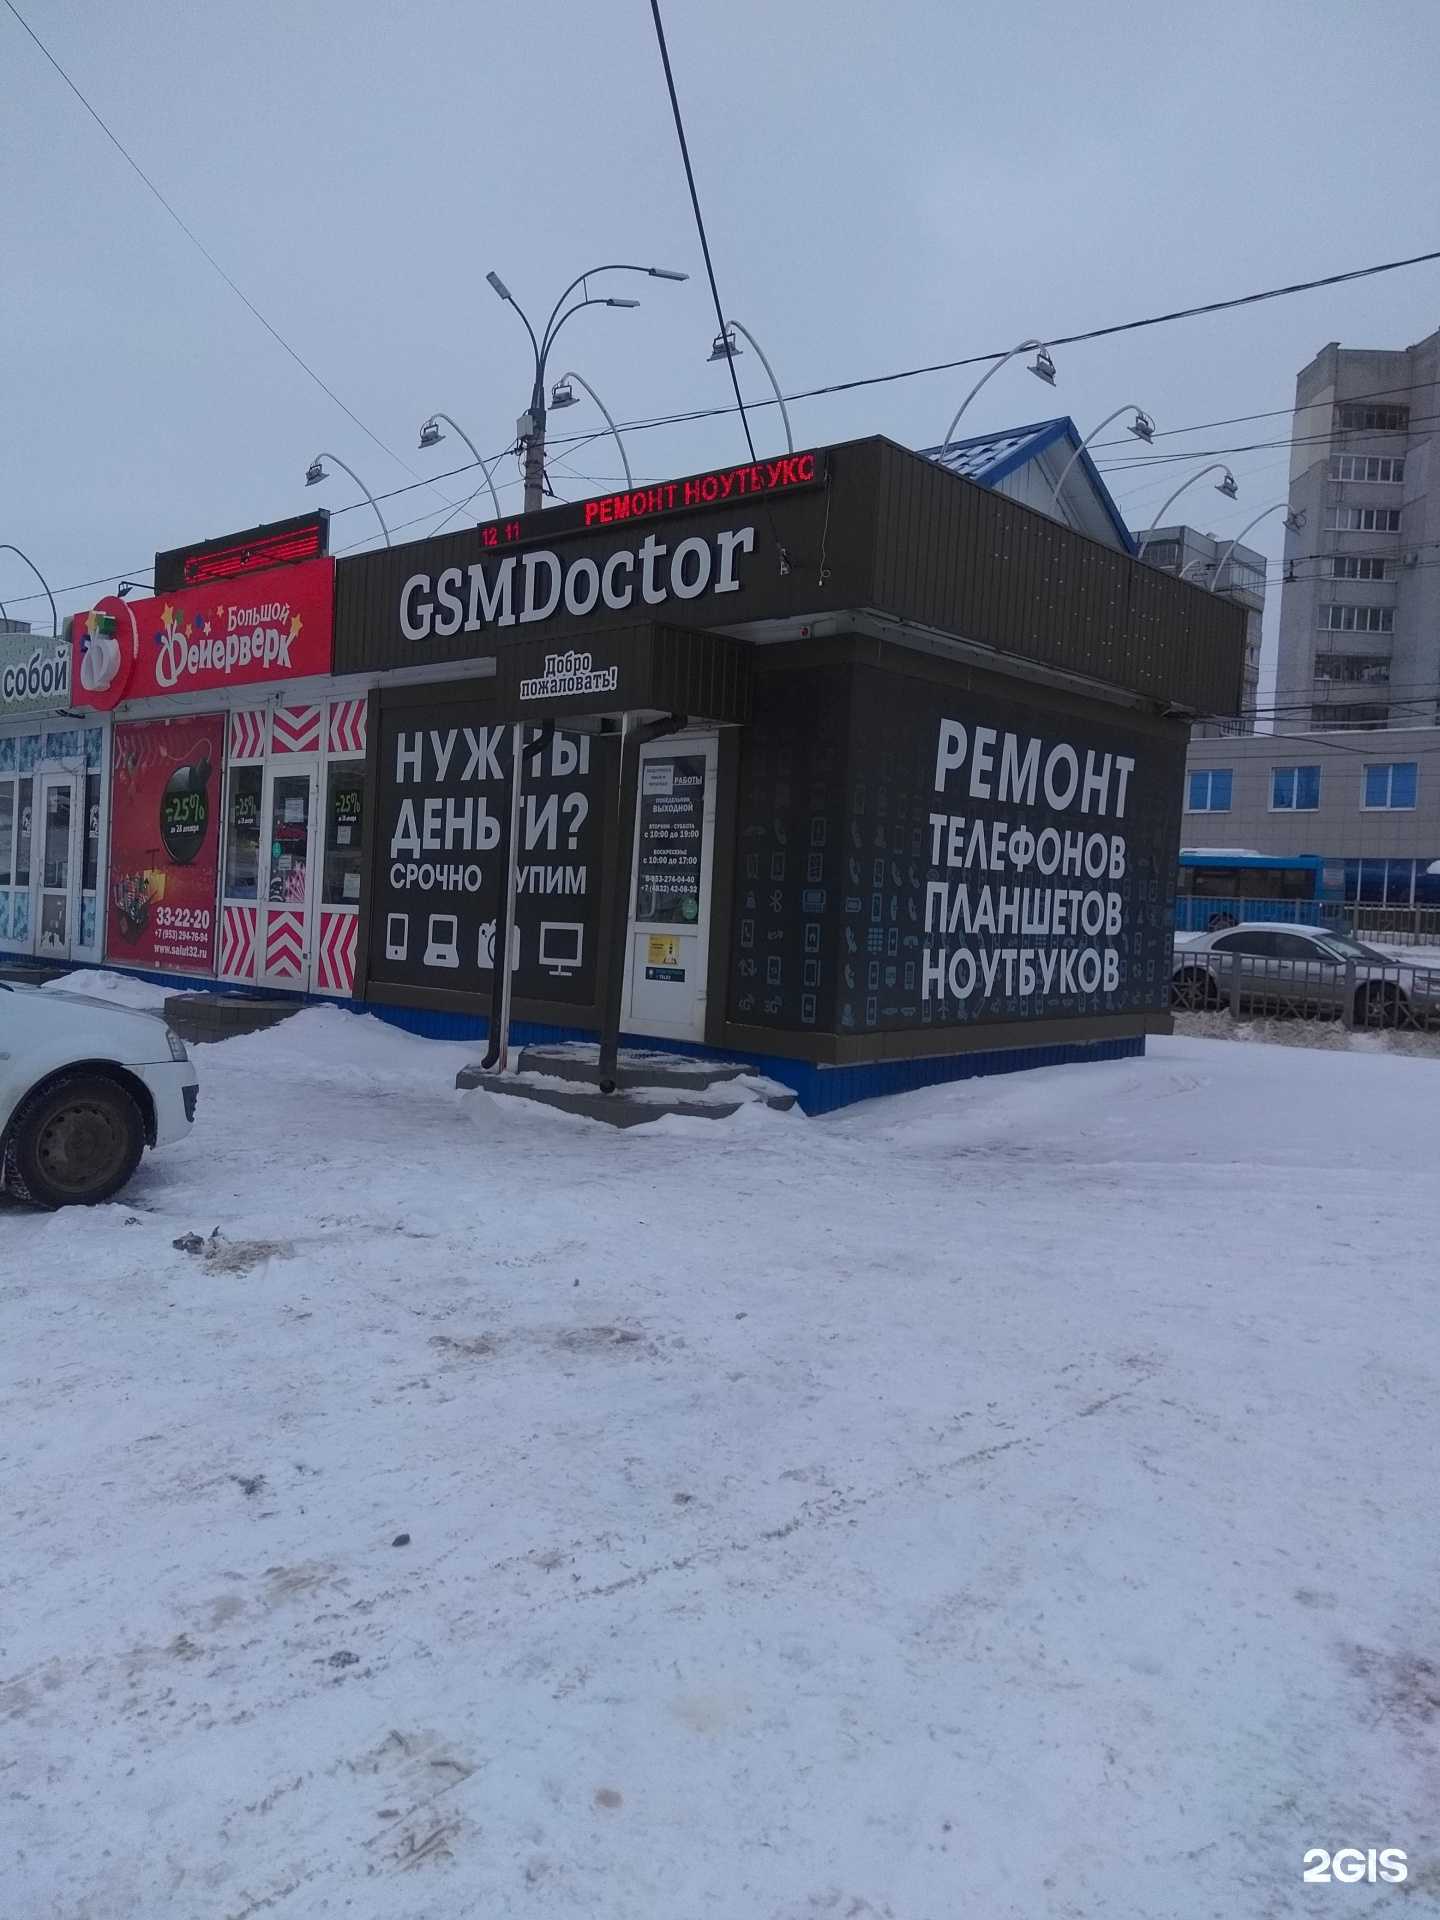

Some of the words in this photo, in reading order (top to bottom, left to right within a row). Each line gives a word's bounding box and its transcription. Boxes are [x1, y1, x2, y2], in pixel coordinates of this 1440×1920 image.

[584, 484, 678, 527] РЕМОНТ
[481, 527, 498, 547] 12
[400, 526, 754, 641] GSMDoctor
[228, 602, 291, 632] Большой
[3, 649, 69, 698] собой
[545, 652, 592, 679] Добро
[520, 667, 618, 699] пожаловать!
[674, 776, 703, 785] РАБОТЫ
[934, 718, 1135, 818] РЕМОНТ
[390, 791, 589, 859] ДЕНЬИ?
[929, 813, 1126, 879] ТЕЛЕФОНОВ
[390, 863, 482, 892] СРОЧНО
[514, 865, 587, 894] УПИМ
[156, 906, 210, 929] 33-22-20
[925, 881, 1122, 936] ПЛАНШЕТОВ
[155, 929, 162, 938] +7
[154, 944, 207, 959] www.salut32.ru
[922, 947, 1119, 1000] НОУТБУКОВ
